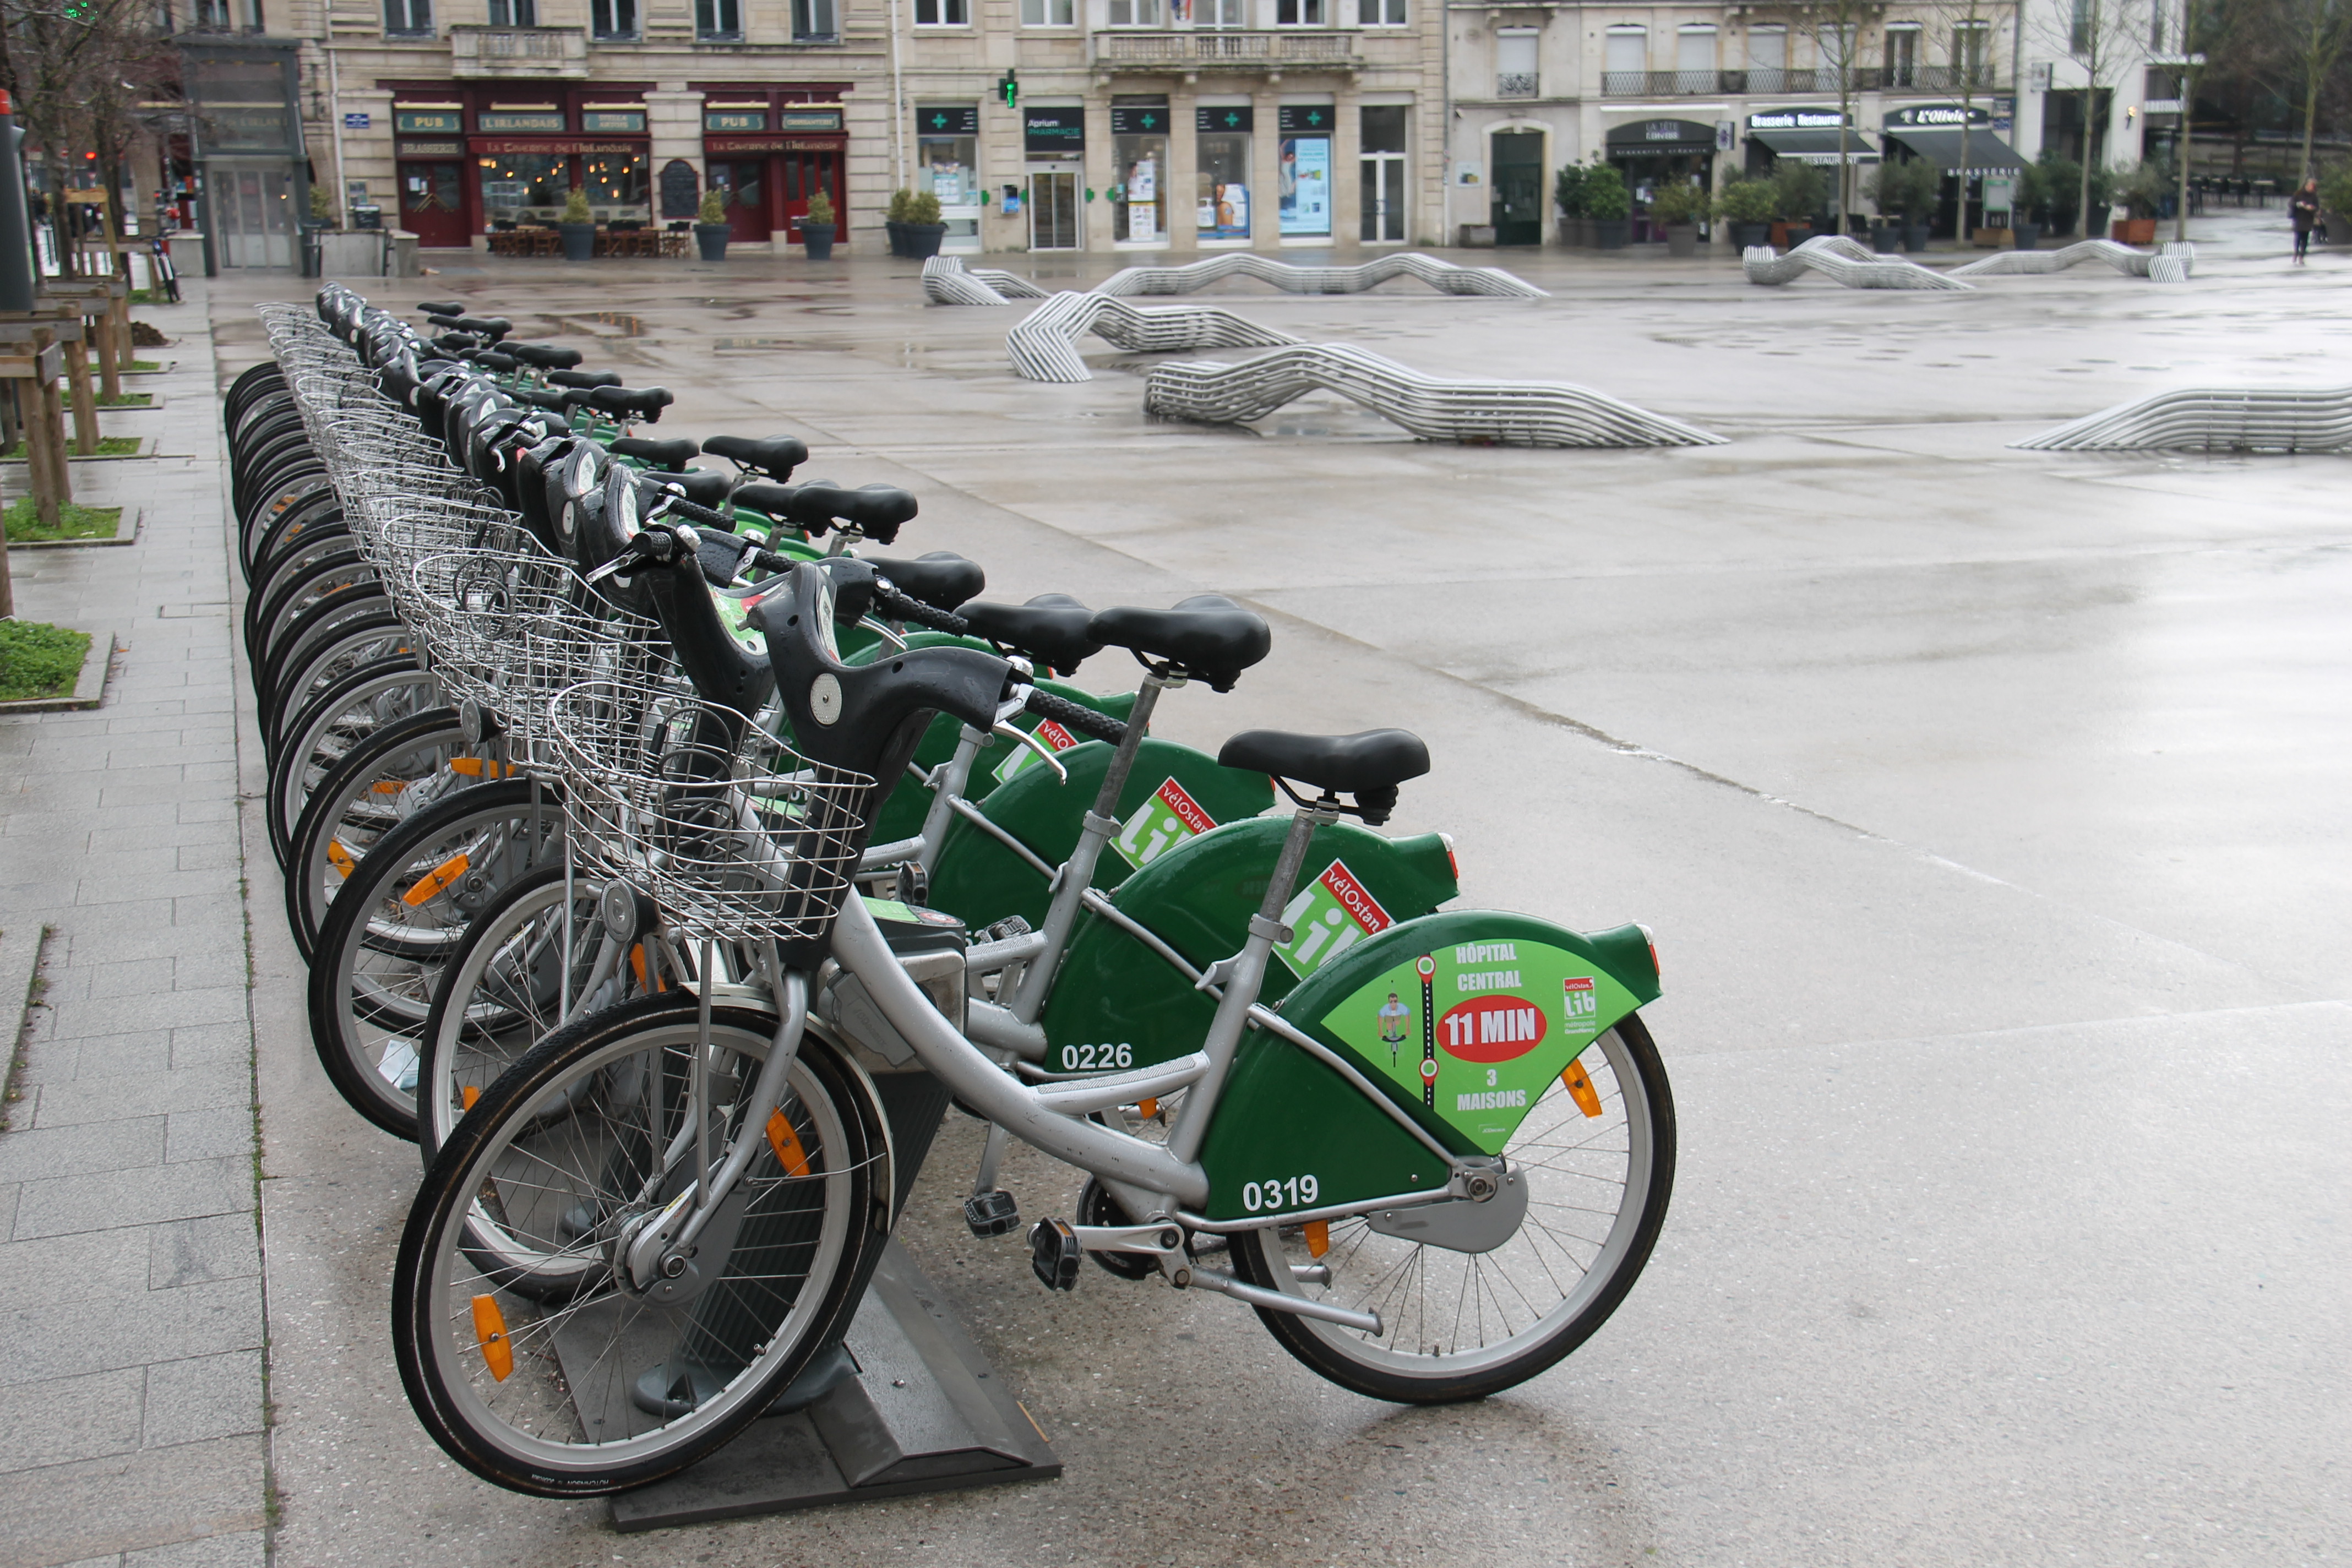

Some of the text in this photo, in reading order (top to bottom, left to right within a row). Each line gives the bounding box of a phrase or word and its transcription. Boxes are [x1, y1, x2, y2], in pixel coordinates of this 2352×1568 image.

[414, 117, 444, 127] PUB
[484, 118, 559, 128] L'IRLANDAIS
[721, 117, 748, 127] PUB
[1027, 119, 1058, 128] Aprium
[1751, 113, 1843, 127] Brasserie Restauran
[1916, 110, 1975, 124] L'Olivie
[1044, 722, 1069, 750] vélO
[1456, 943, 1517, 963] HÔPITAL
[1457, 970, 1522, 991] CENTRAL
[1445, 1008, 1536, 1046] 11 MIN
[1062, 1043, 1132, 1070] 0226
[1487, 1069, 1496, 1086] 3
[1457, 1089, 1526, 1111] MAISONS
[1243, 1174, 1318, 1211] 0319
